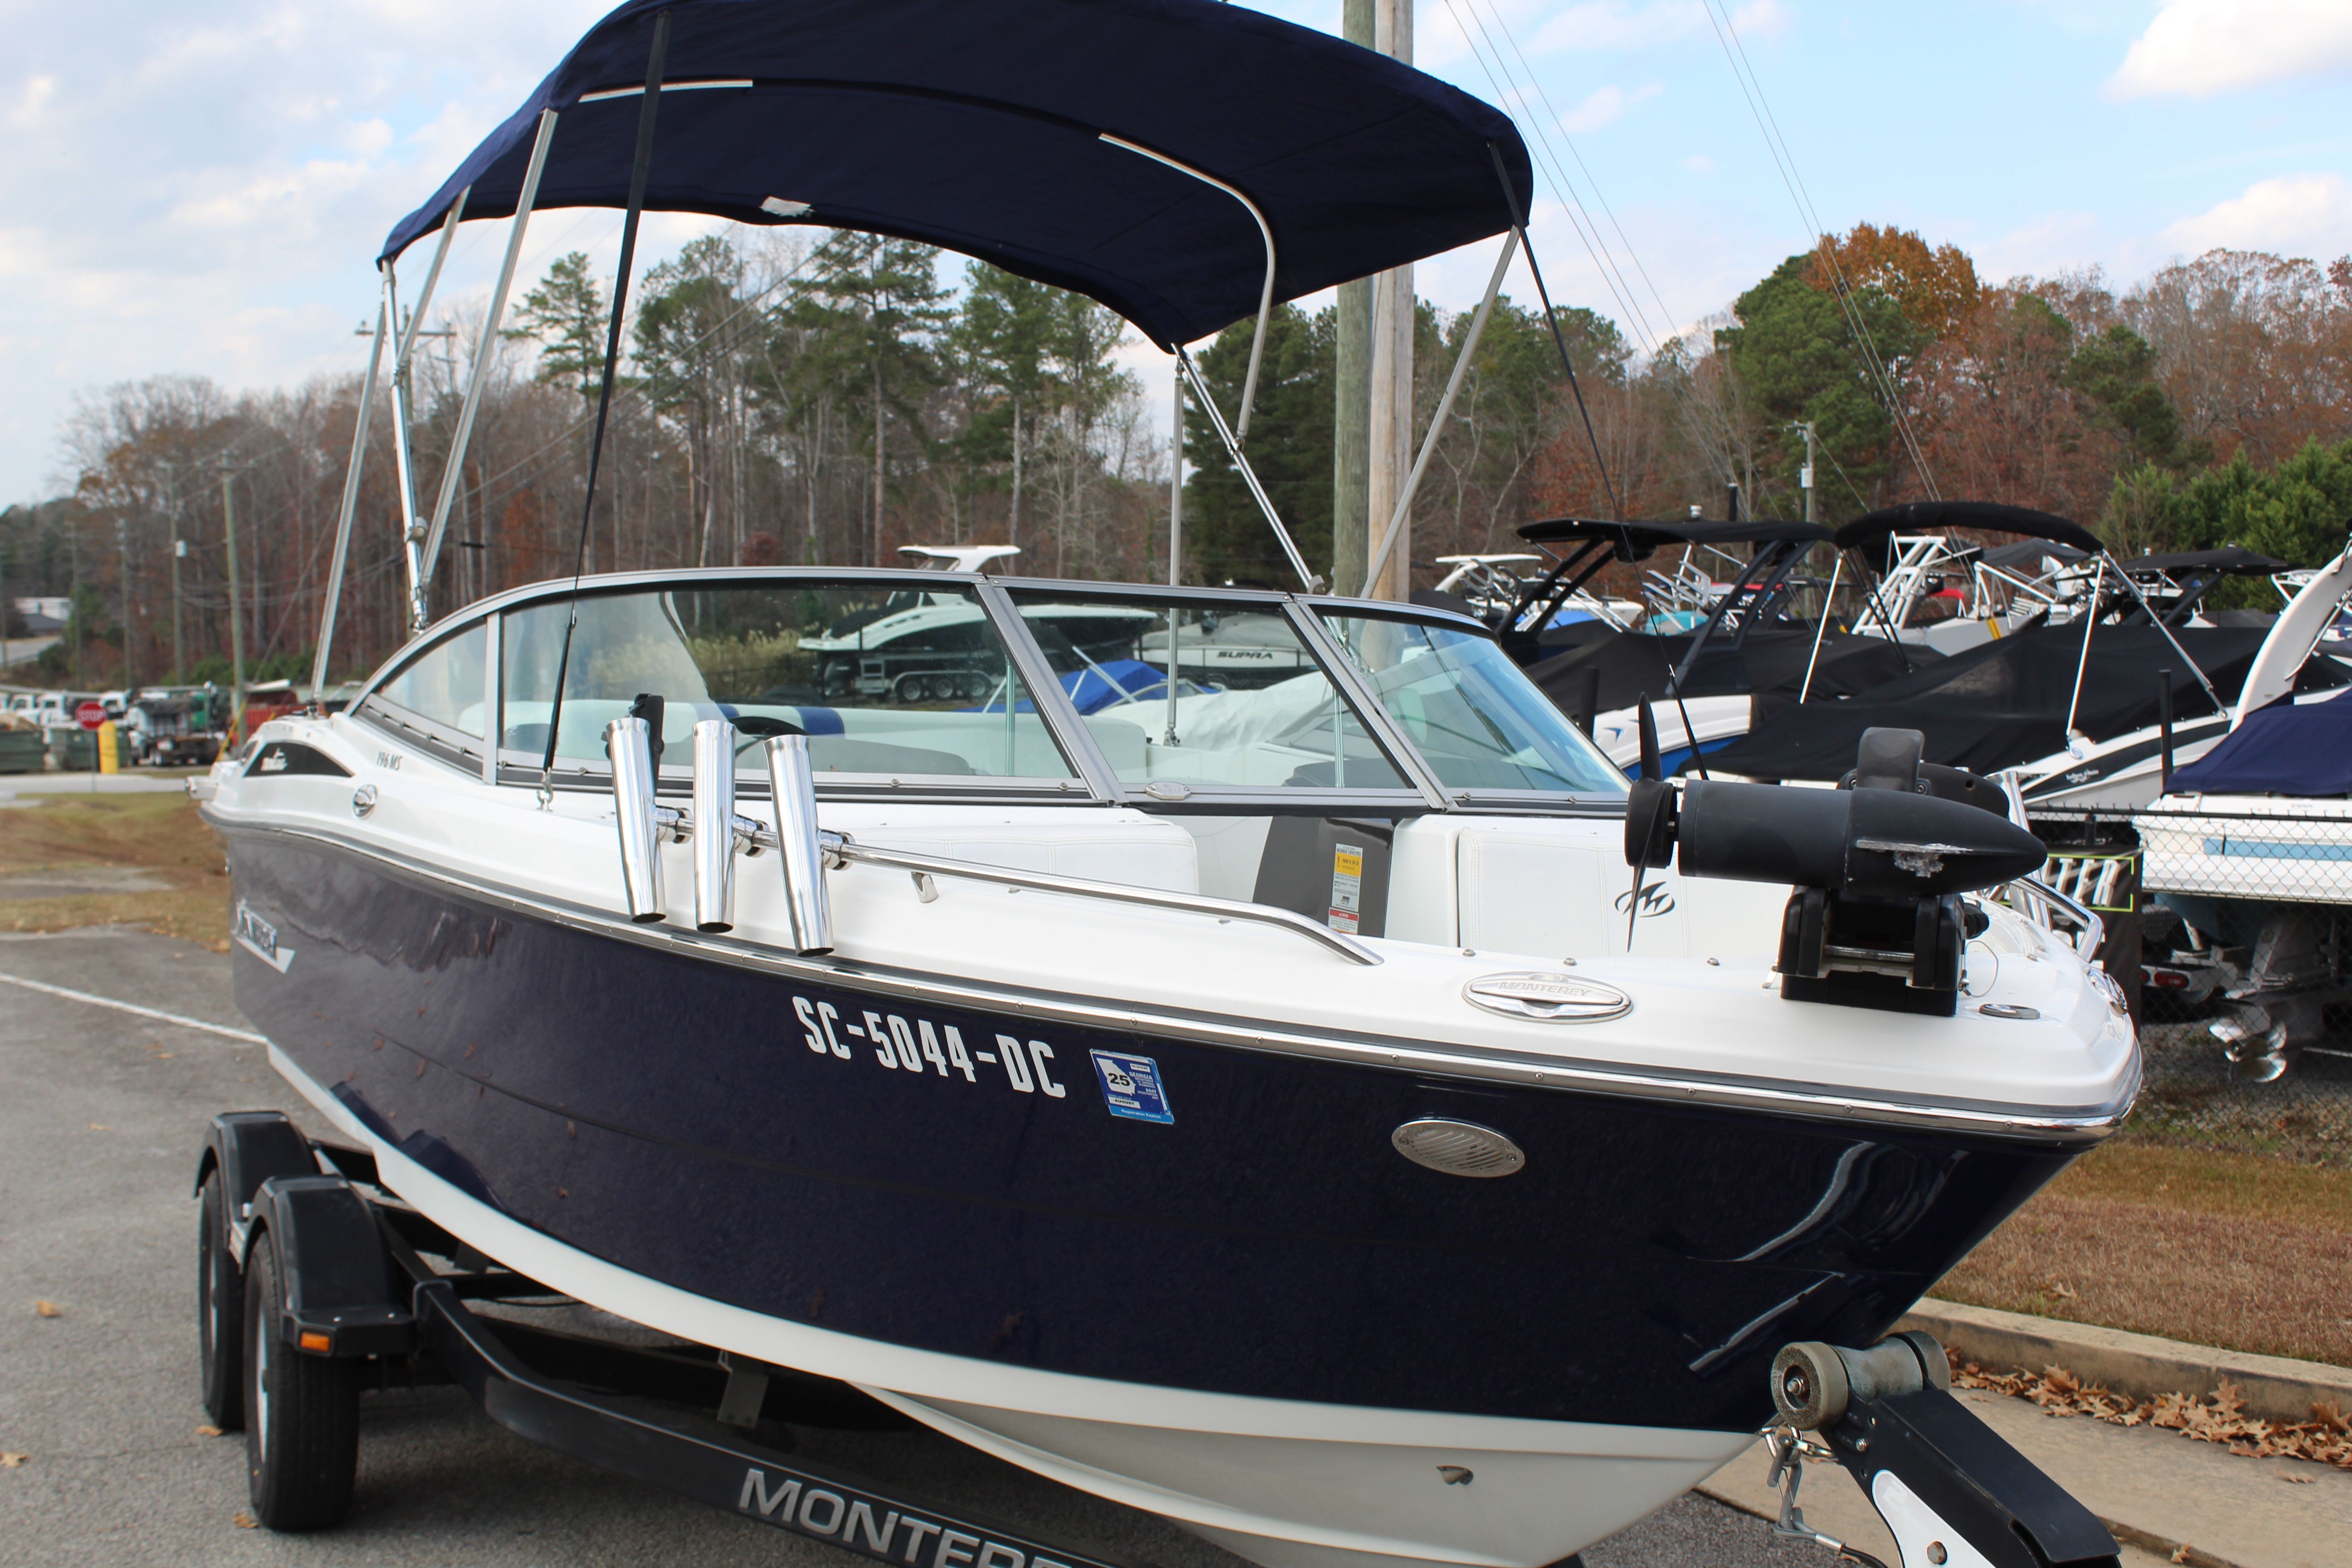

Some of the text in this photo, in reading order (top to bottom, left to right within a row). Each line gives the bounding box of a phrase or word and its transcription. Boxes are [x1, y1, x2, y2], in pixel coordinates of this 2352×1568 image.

[1216, 651, 1273, 660] SUPRA
[80, 710, 104, 721] STOP
[376, 751, 402, 771] 196 MS
[1498, 982, 1592, 996] MONTEREY
[792, 996, 1066, 1098] SC-5044-DC
[1108, 1073, 1130, 1086] 25
[1129, 1071, 1153, 1080] GEORGIA
[1121, 1108, 1145, 1117] Registration
